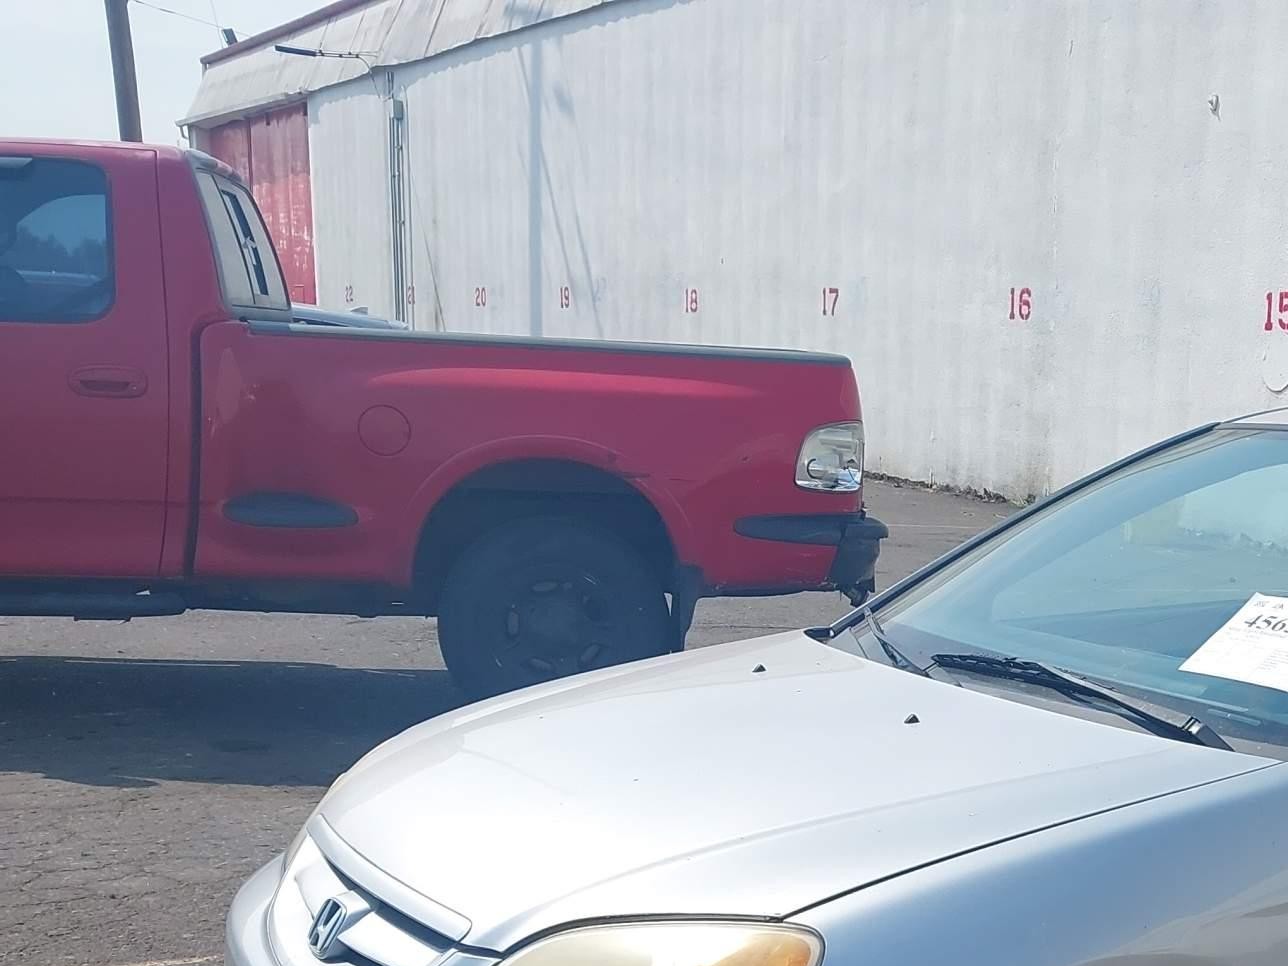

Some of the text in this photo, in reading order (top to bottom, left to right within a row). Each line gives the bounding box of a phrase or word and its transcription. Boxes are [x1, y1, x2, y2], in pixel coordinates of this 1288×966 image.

[475, 287, 487, 306] 20
[559, 287, 571, 309] 19
[685, 288, 699, 313] 18
[822, 287, 839, 316] 17
[1008, 287, 1032, 321] 16
